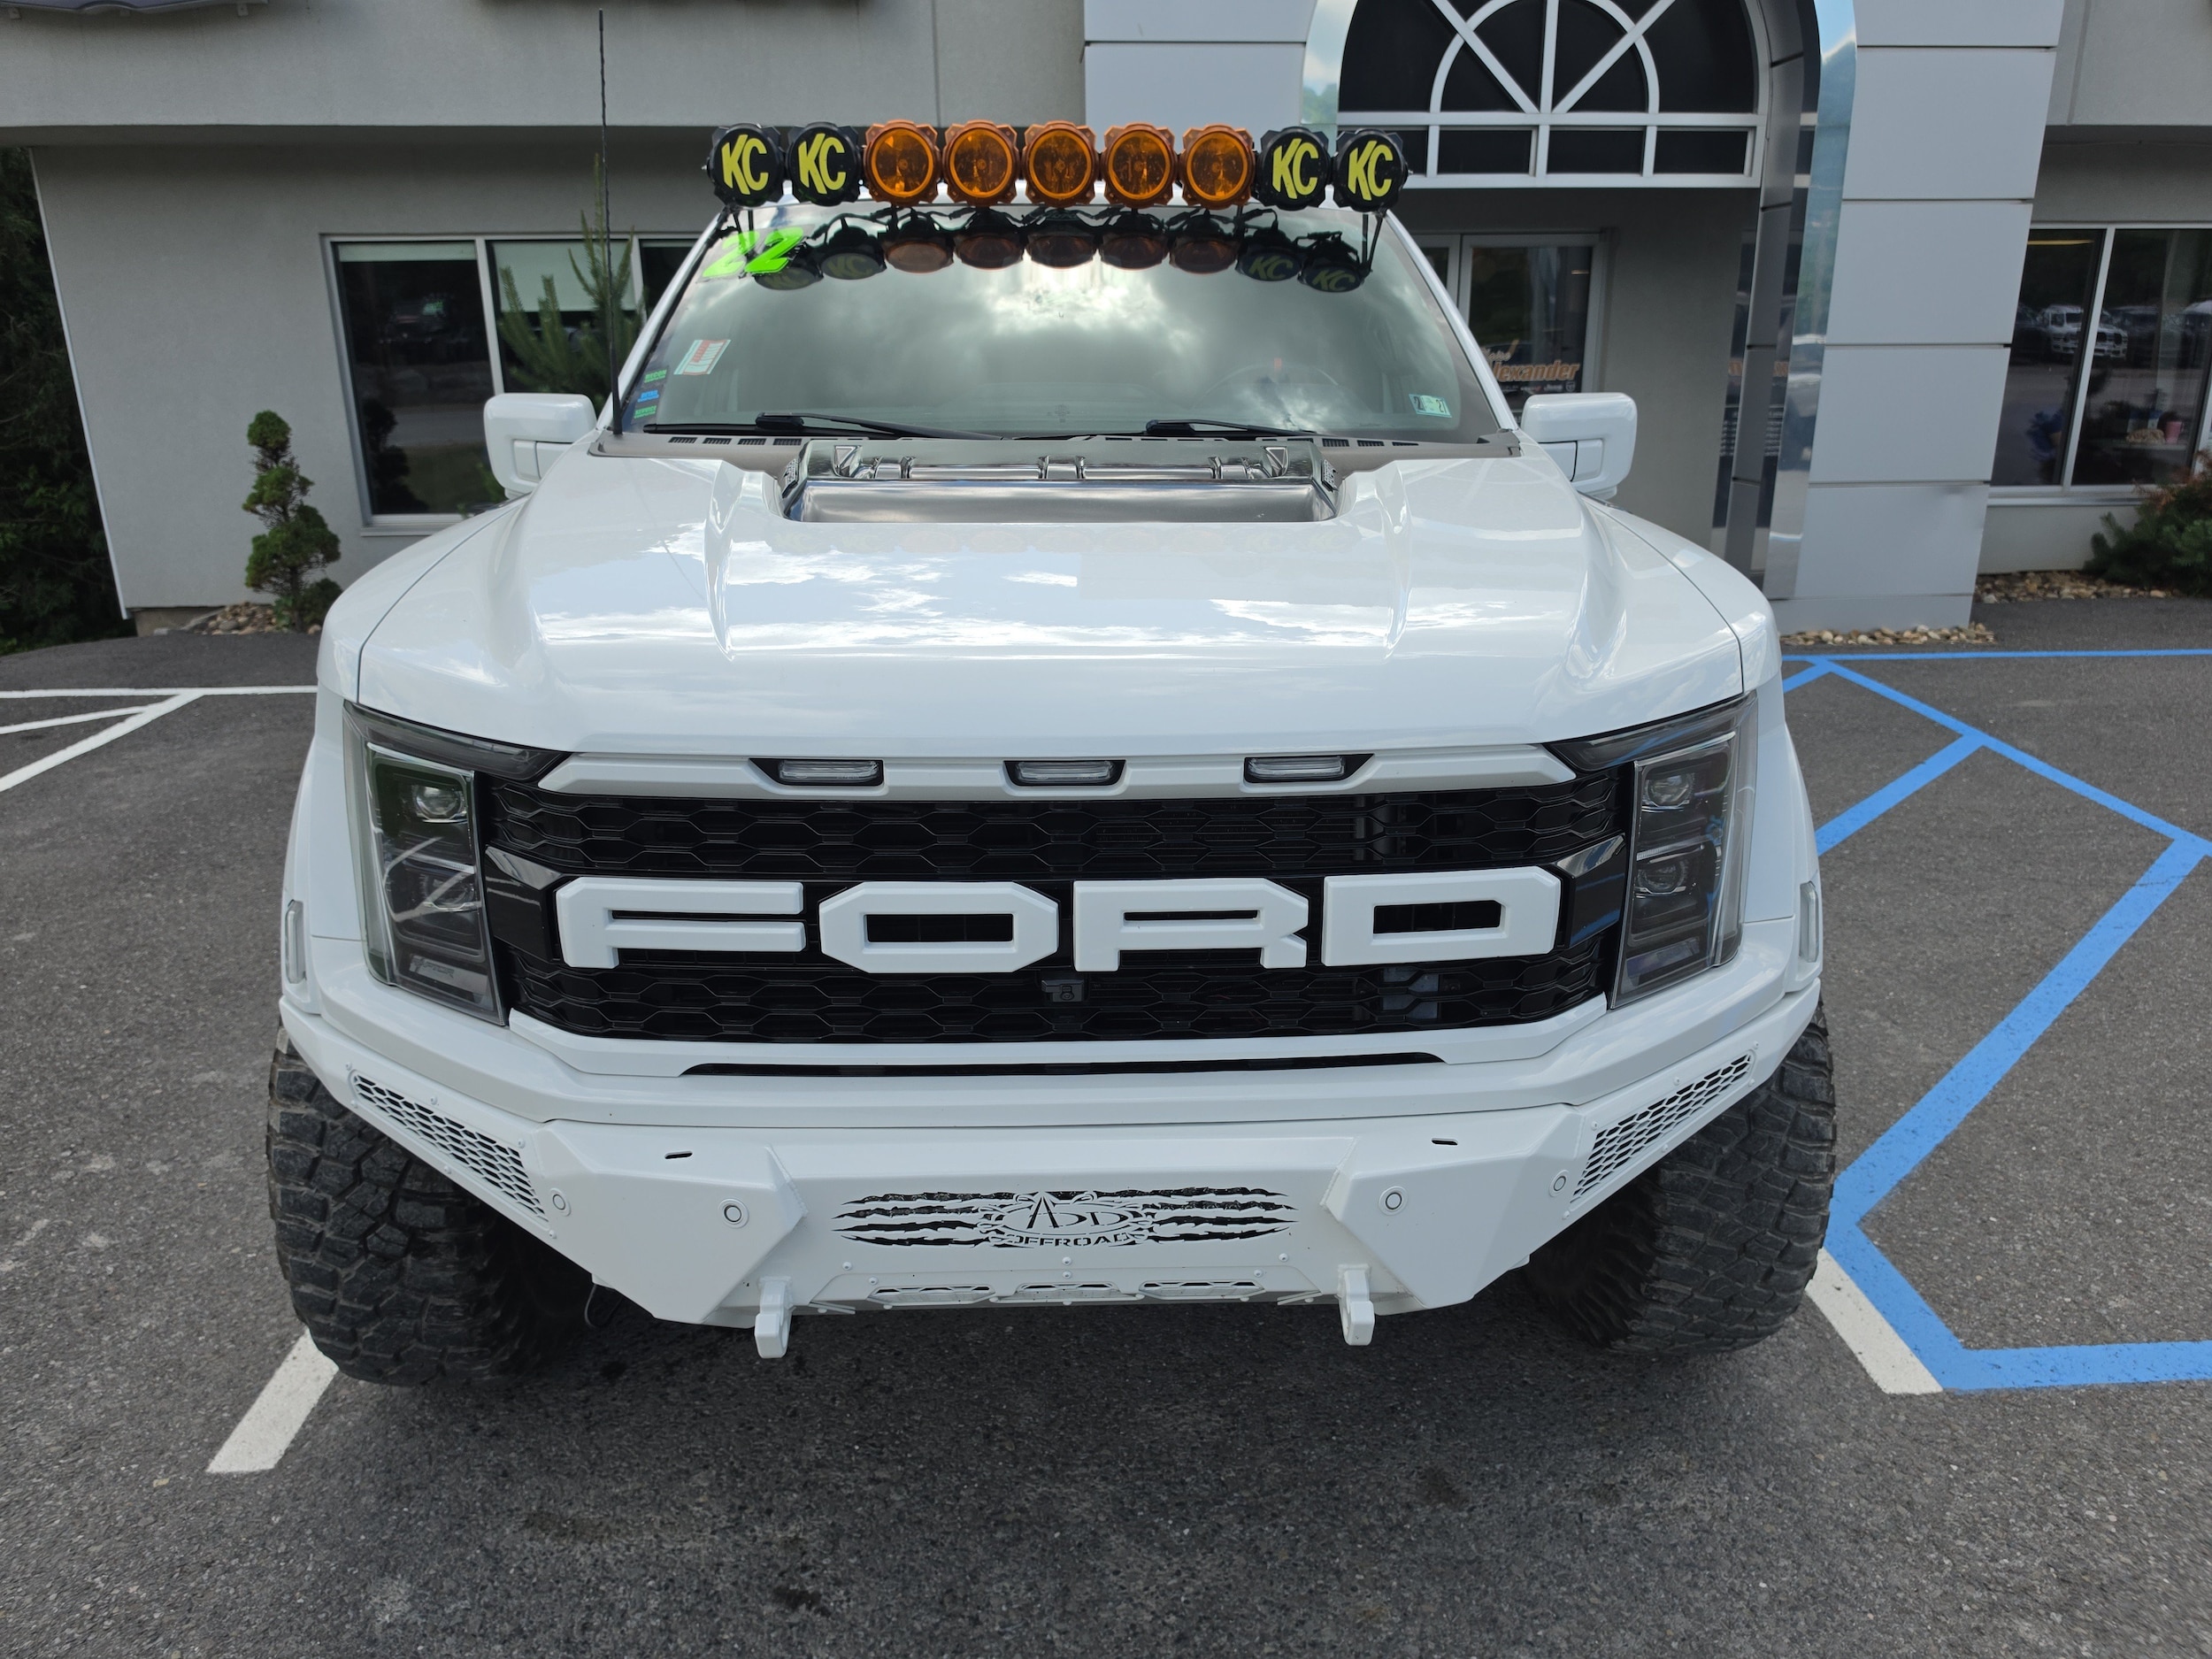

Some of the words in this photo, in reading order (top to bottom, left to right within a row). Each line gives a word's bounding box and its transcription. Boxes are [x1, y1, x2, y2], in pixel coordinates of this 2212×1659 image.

[721, 133, 769, 195] KC
[798, 133, 847, 195] KC
[1271, 138, 1319, 199] KC
[1348, 140, 1394, 201] KC
[702, 227, 804, 278] 22
[1491, 359, 1580, 382] lexander
[556, 865, 1561, 973] FORD
[1006, 1233, 1129, 1247] OFFROAD
